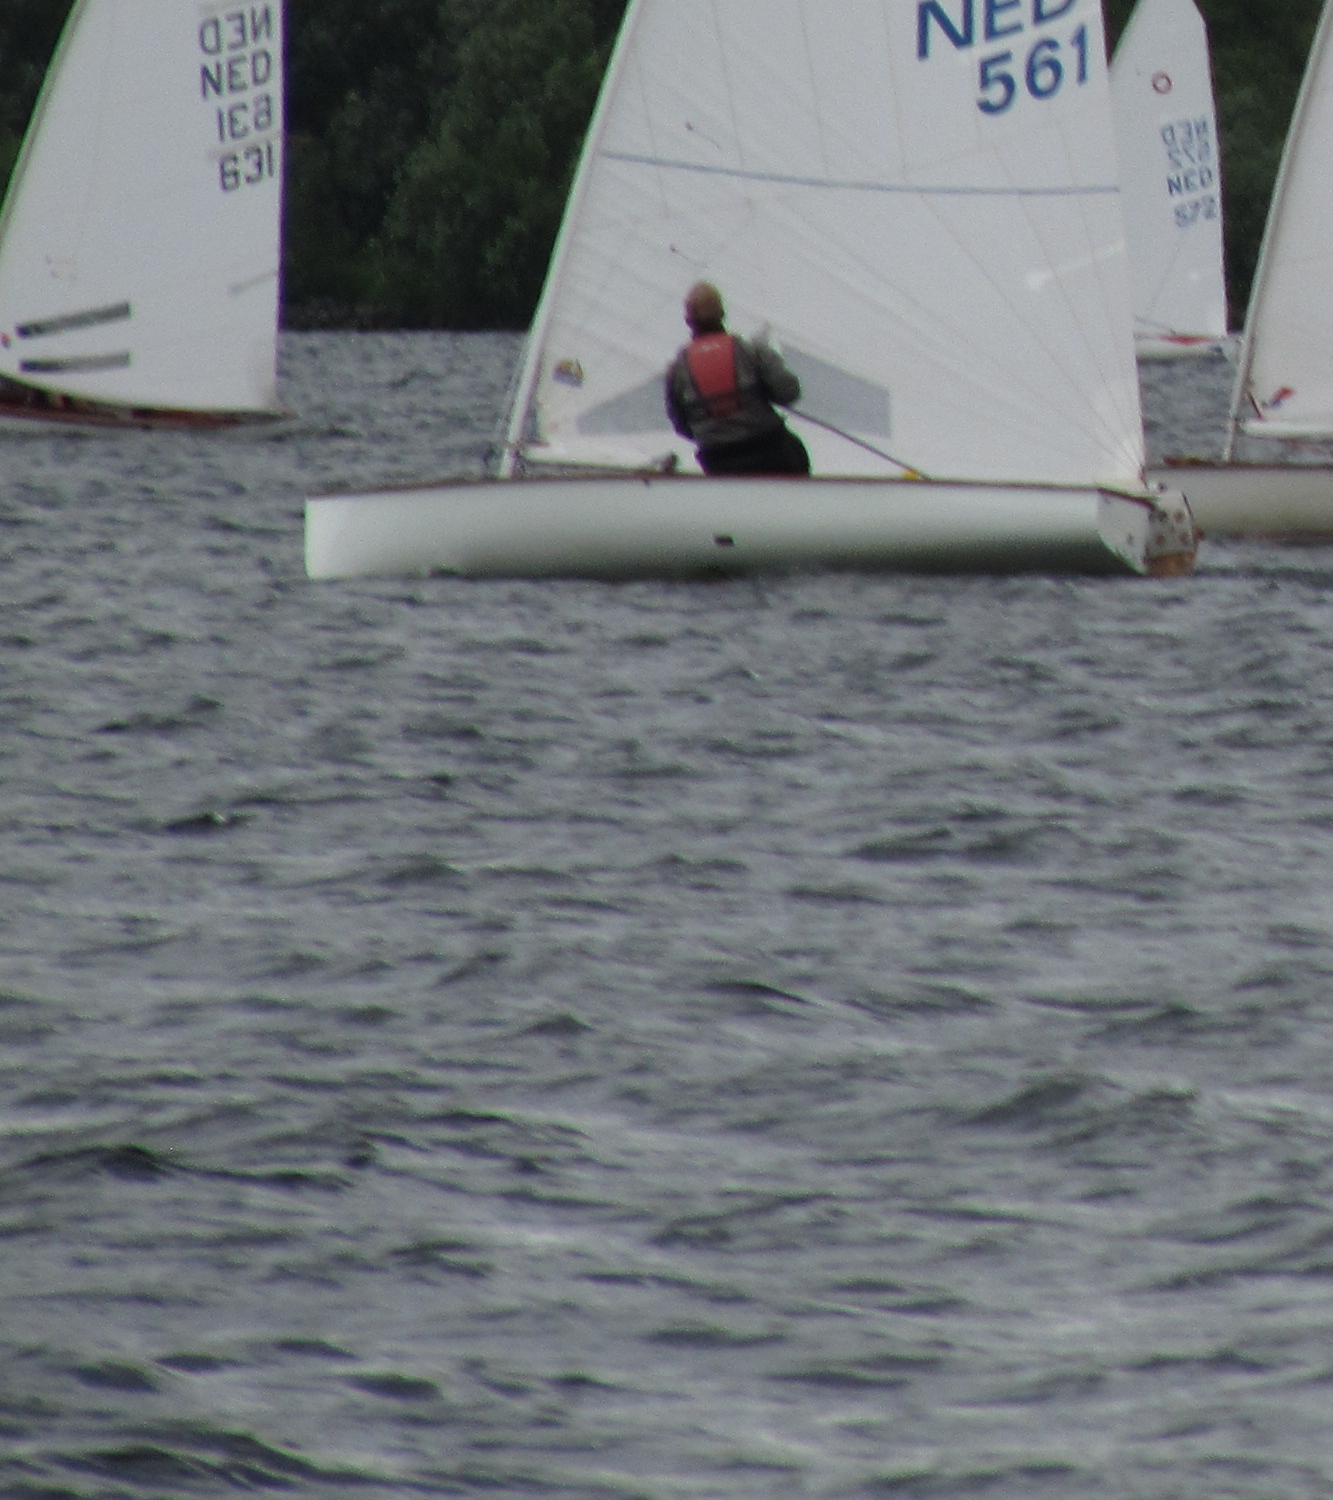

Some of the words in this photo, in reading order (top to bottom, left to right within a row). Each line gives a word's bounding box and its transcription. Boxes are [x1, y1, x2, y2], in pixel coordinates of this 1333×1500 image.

[200, 50, 271, 98] NED
[976, 23, 1088, 116] 561
[219, 141, 274, 192] 631
[1167, 166, 1213, 197] NED
